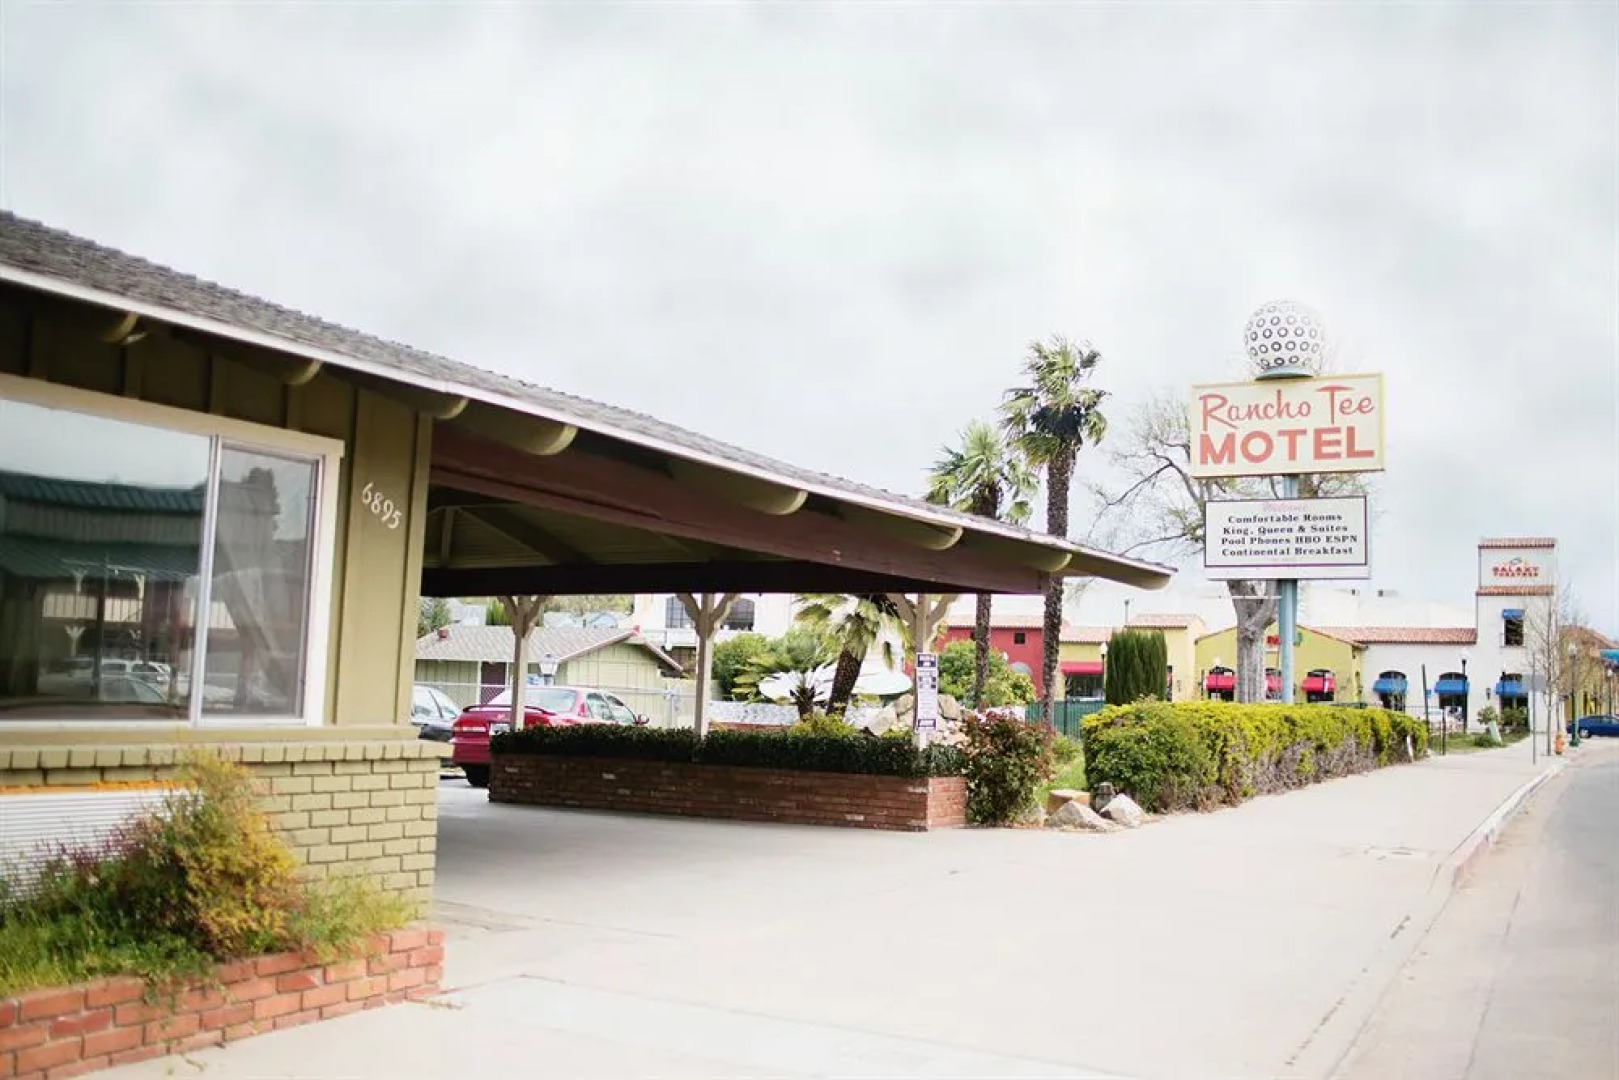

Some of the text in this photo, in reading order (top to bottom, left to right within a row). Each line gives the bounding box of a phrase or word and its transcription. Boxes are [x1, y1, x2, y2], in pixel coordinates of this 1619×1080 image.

[1198, 386, 1375, 431] Rancho Tee
[1199, 426, 1375, 466] MOTEL
[362, 482, 401, 529] 6895
[1228, 514, 1342, 523] Comfortable Rooms
[1257, 526, 1293, 536] Queen
[1298, 525, 1305, 533] &
[1311, 525, 1348, 533] Suites
[1221, 535, 1357, 545] Pool Phones HBO ESPN
[1221, 546, 1352, 556] Continental Breakfast
